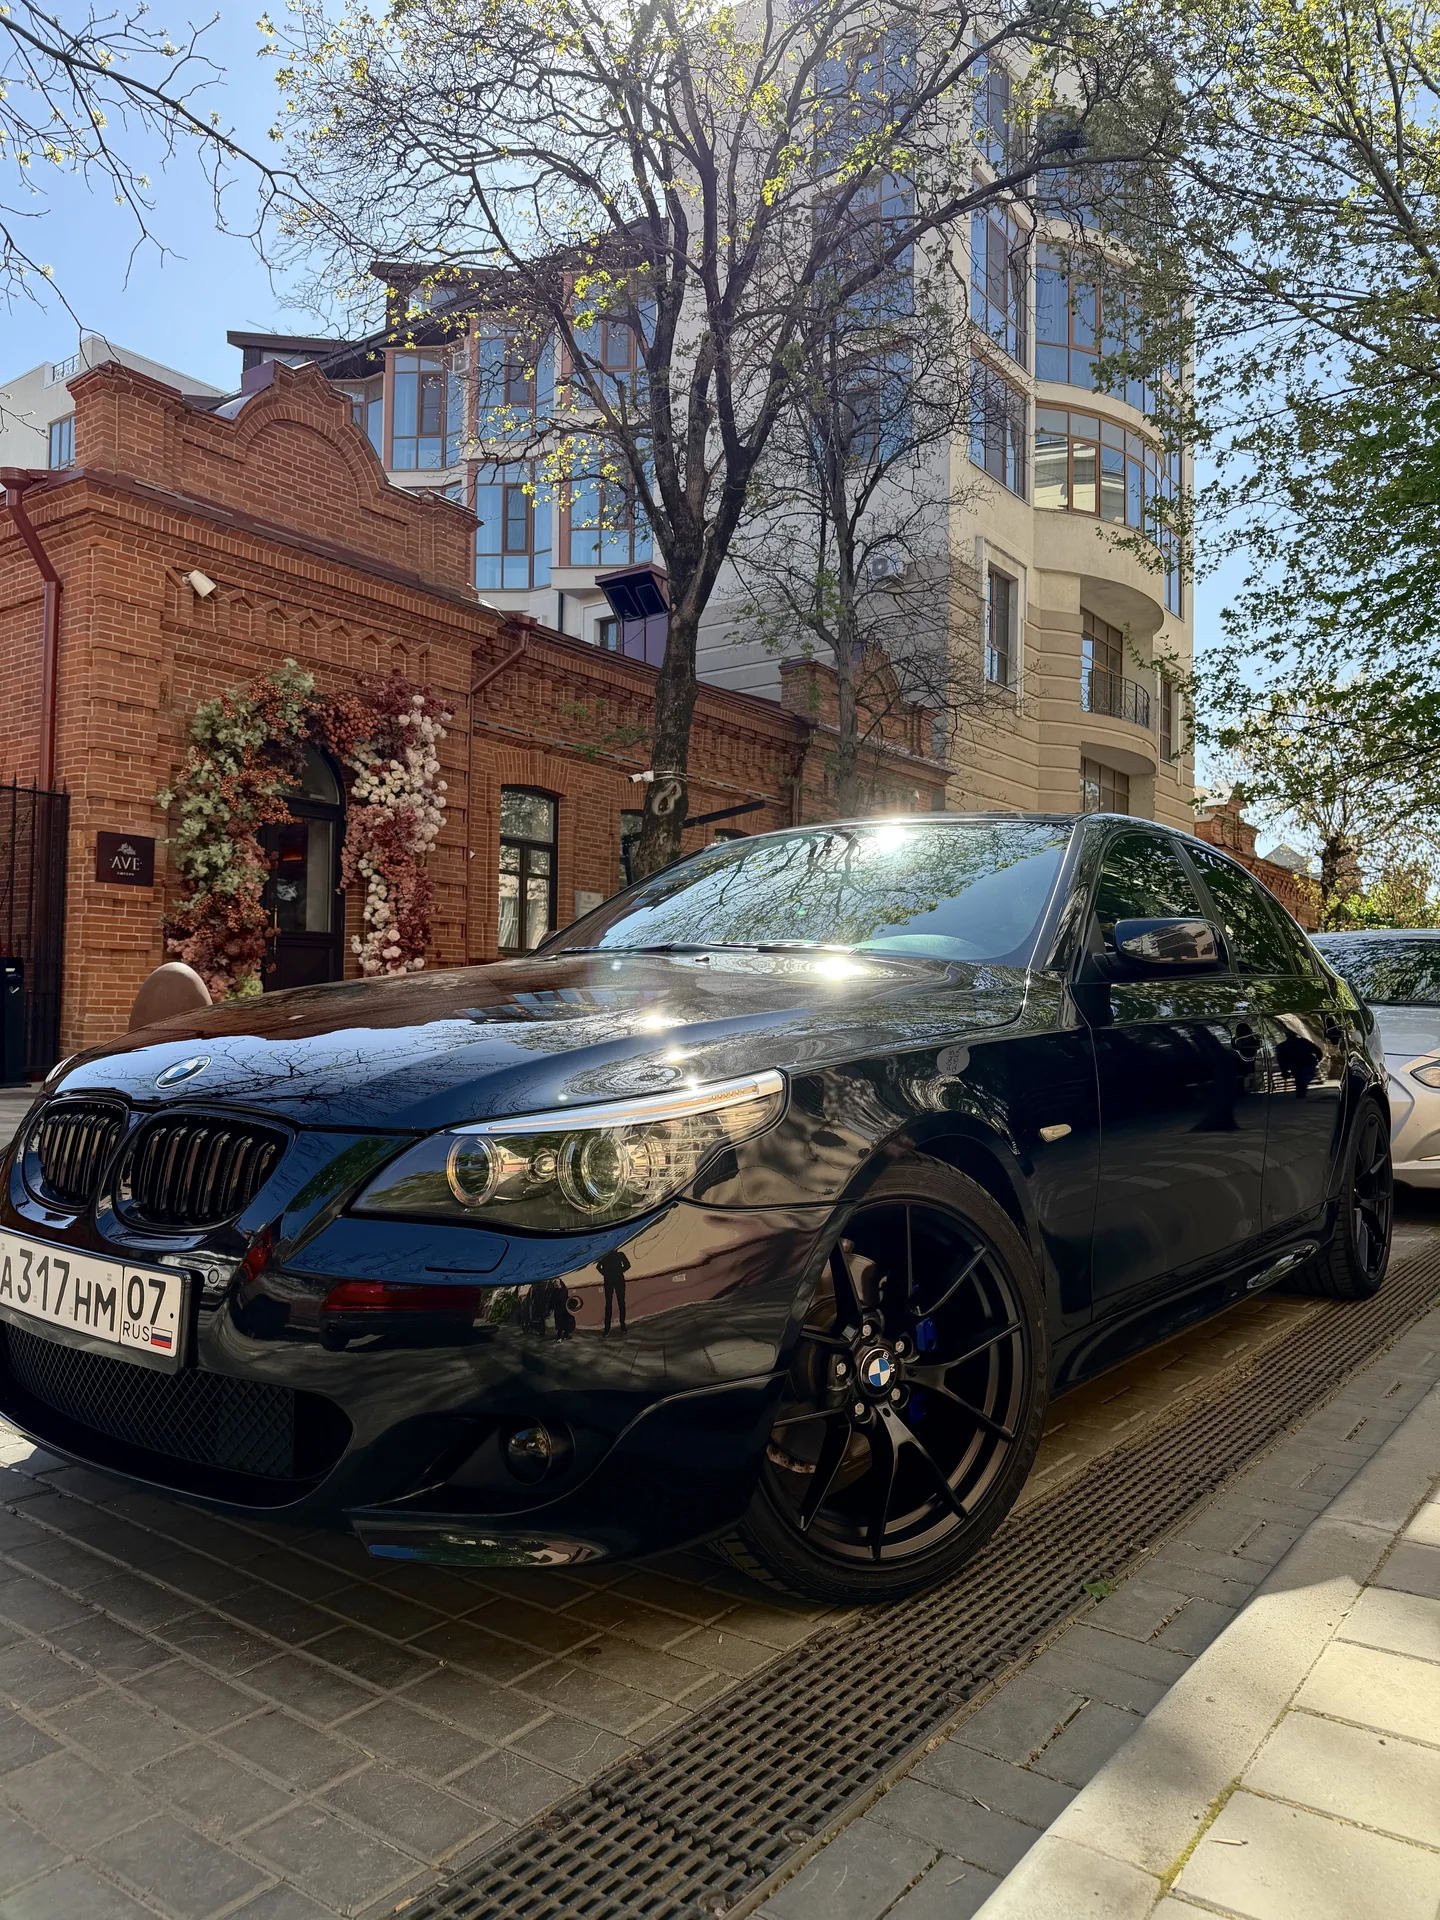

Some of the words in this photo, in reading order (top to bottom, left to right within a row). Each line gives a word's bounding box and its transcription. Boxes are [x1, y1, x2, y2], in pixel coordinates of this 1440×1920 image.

[111, 856, 140, 871] AVE
[127, 1275, 167, 1325] 07
[123, 1321, 150, 1342] RUS
